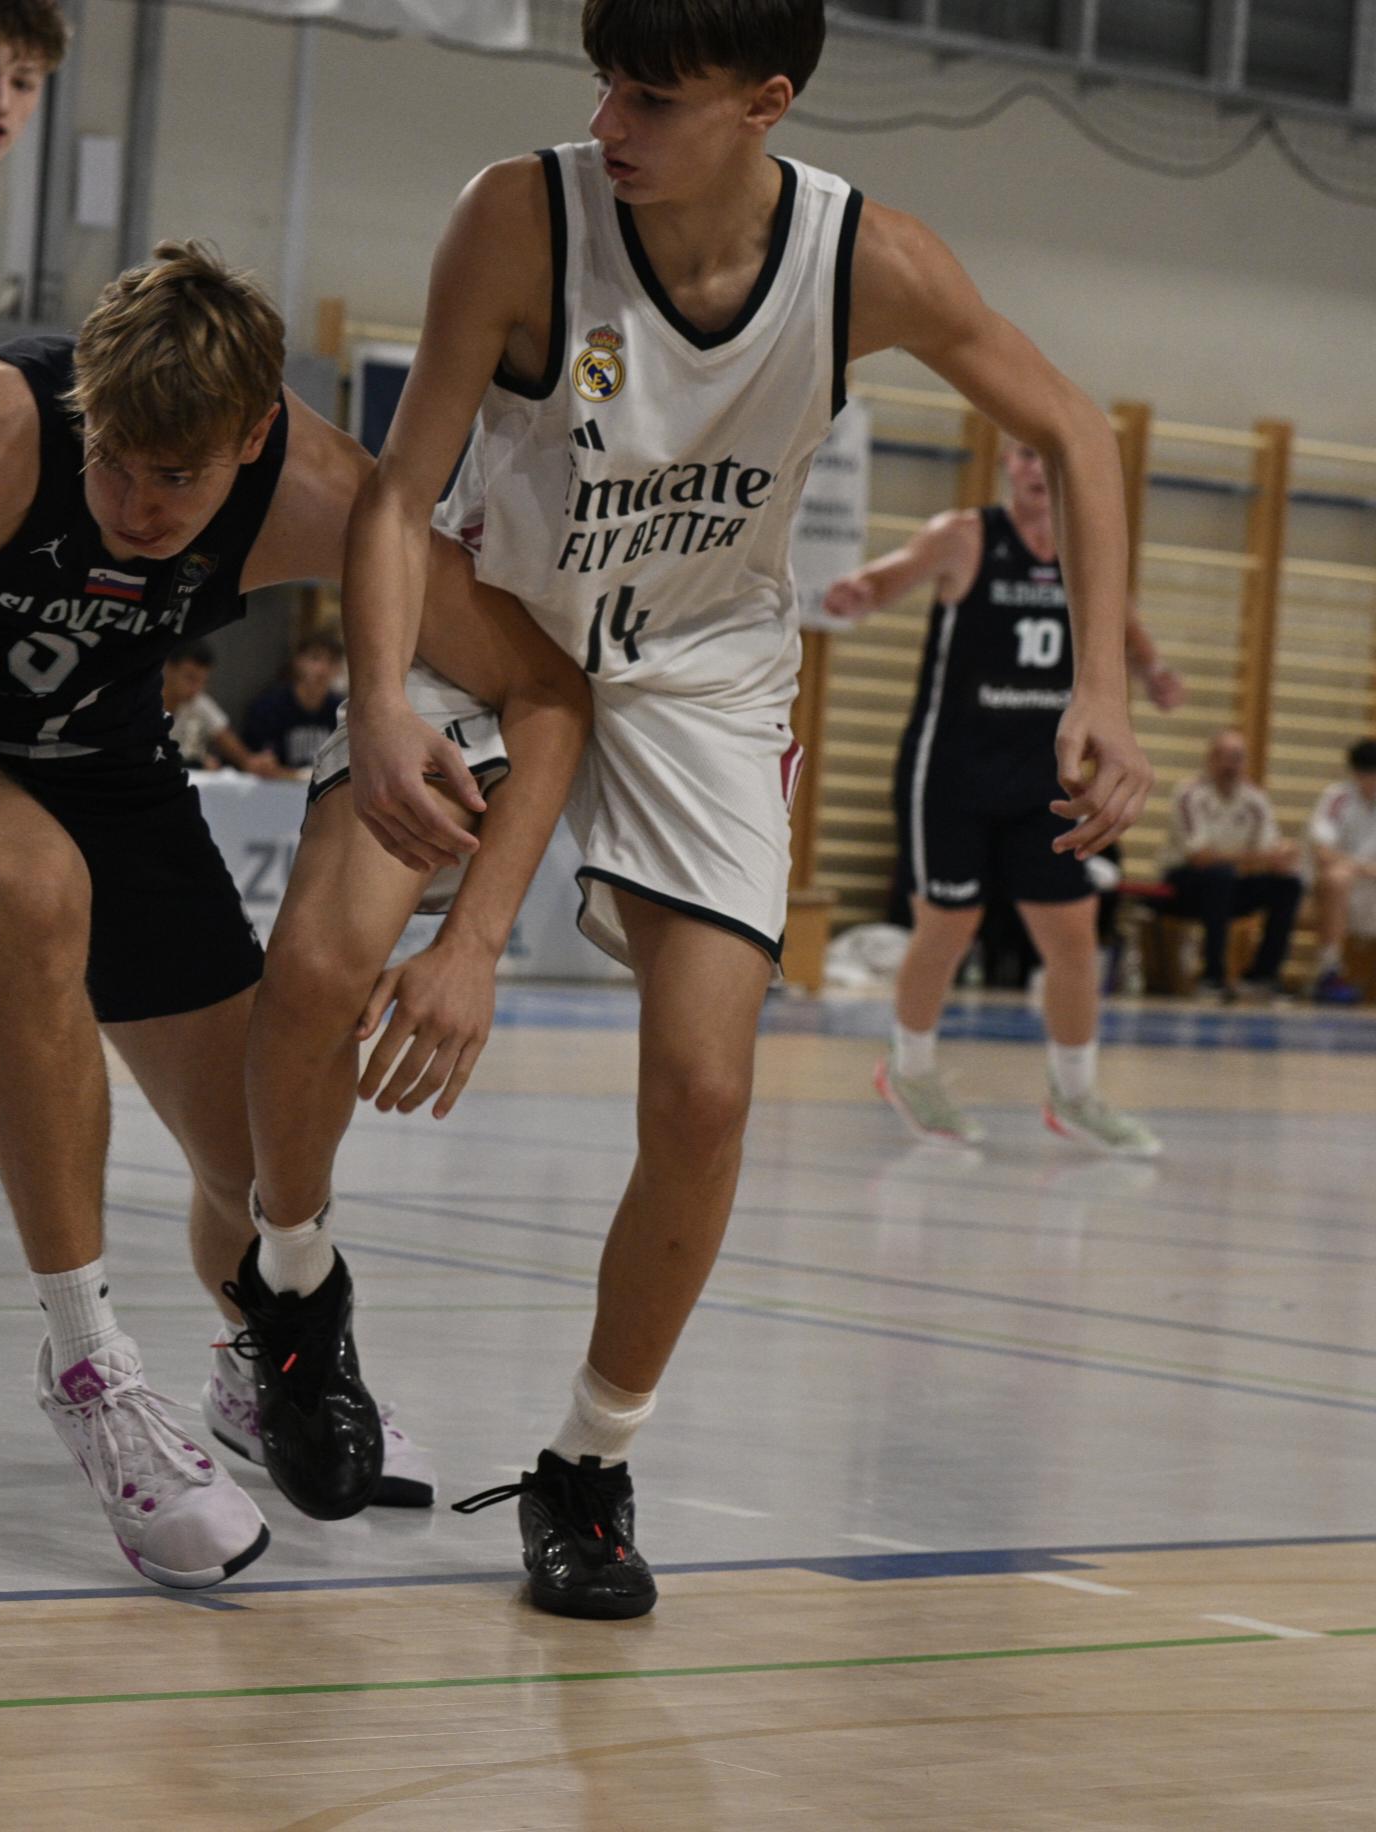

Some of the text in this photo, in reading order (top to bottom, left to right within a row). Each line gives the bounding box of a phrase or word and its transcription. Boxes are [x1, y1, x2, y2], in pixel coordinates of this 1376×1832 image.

[565, 455, 778, 521] mirate
[557, 511, 747, 573] FLY BETTER
[584, 585, 651, 673] 14
[1014, 617, 1063, 667] 10
